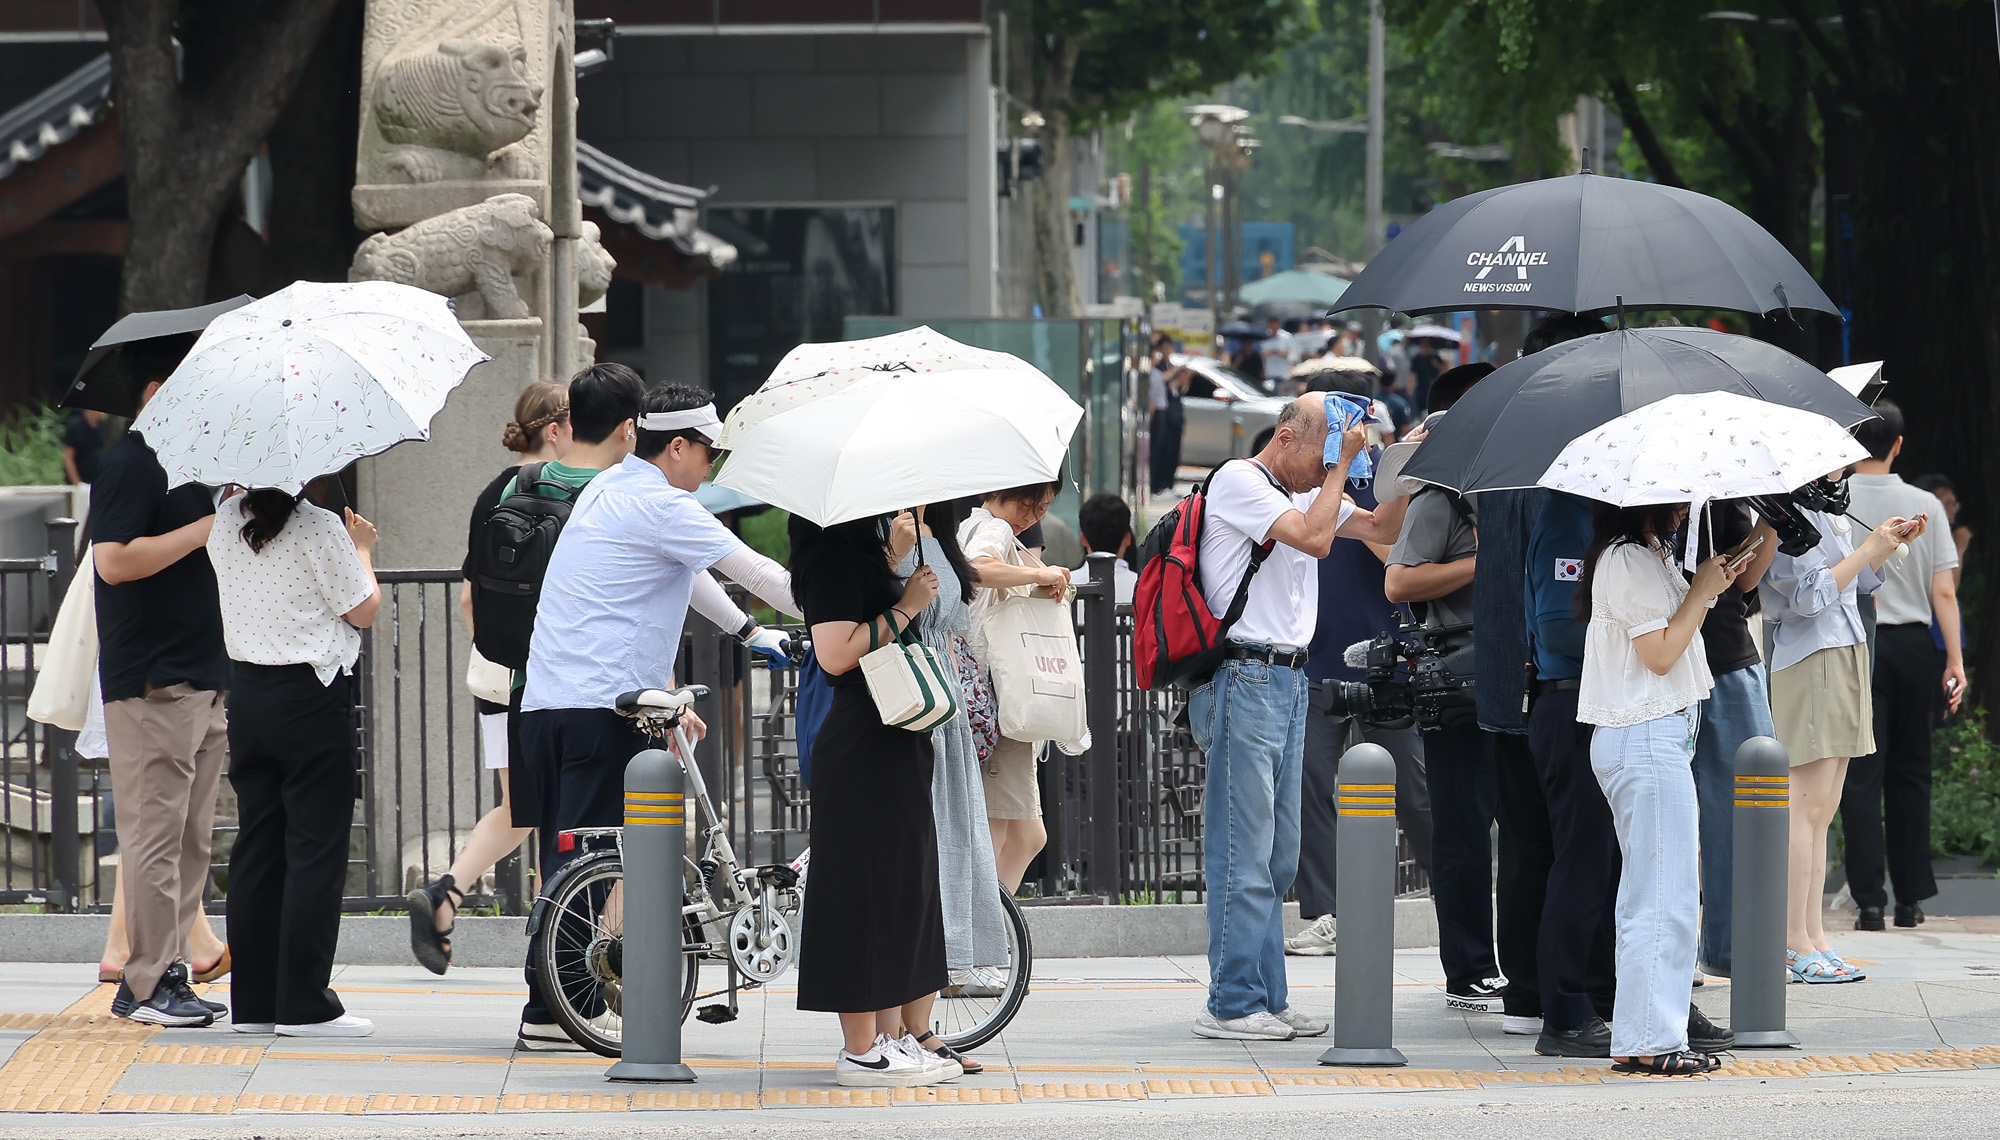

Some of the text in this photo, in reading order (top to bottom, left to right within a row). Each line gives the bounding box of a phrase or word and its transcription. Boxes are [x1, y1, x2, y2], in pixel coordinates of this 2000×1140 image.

[1466, 252, 1549, 266] CHANNEL
[1463, 283, 1532, 292] NEWSVISION
[1035, 656, 1067, 674] UKP
